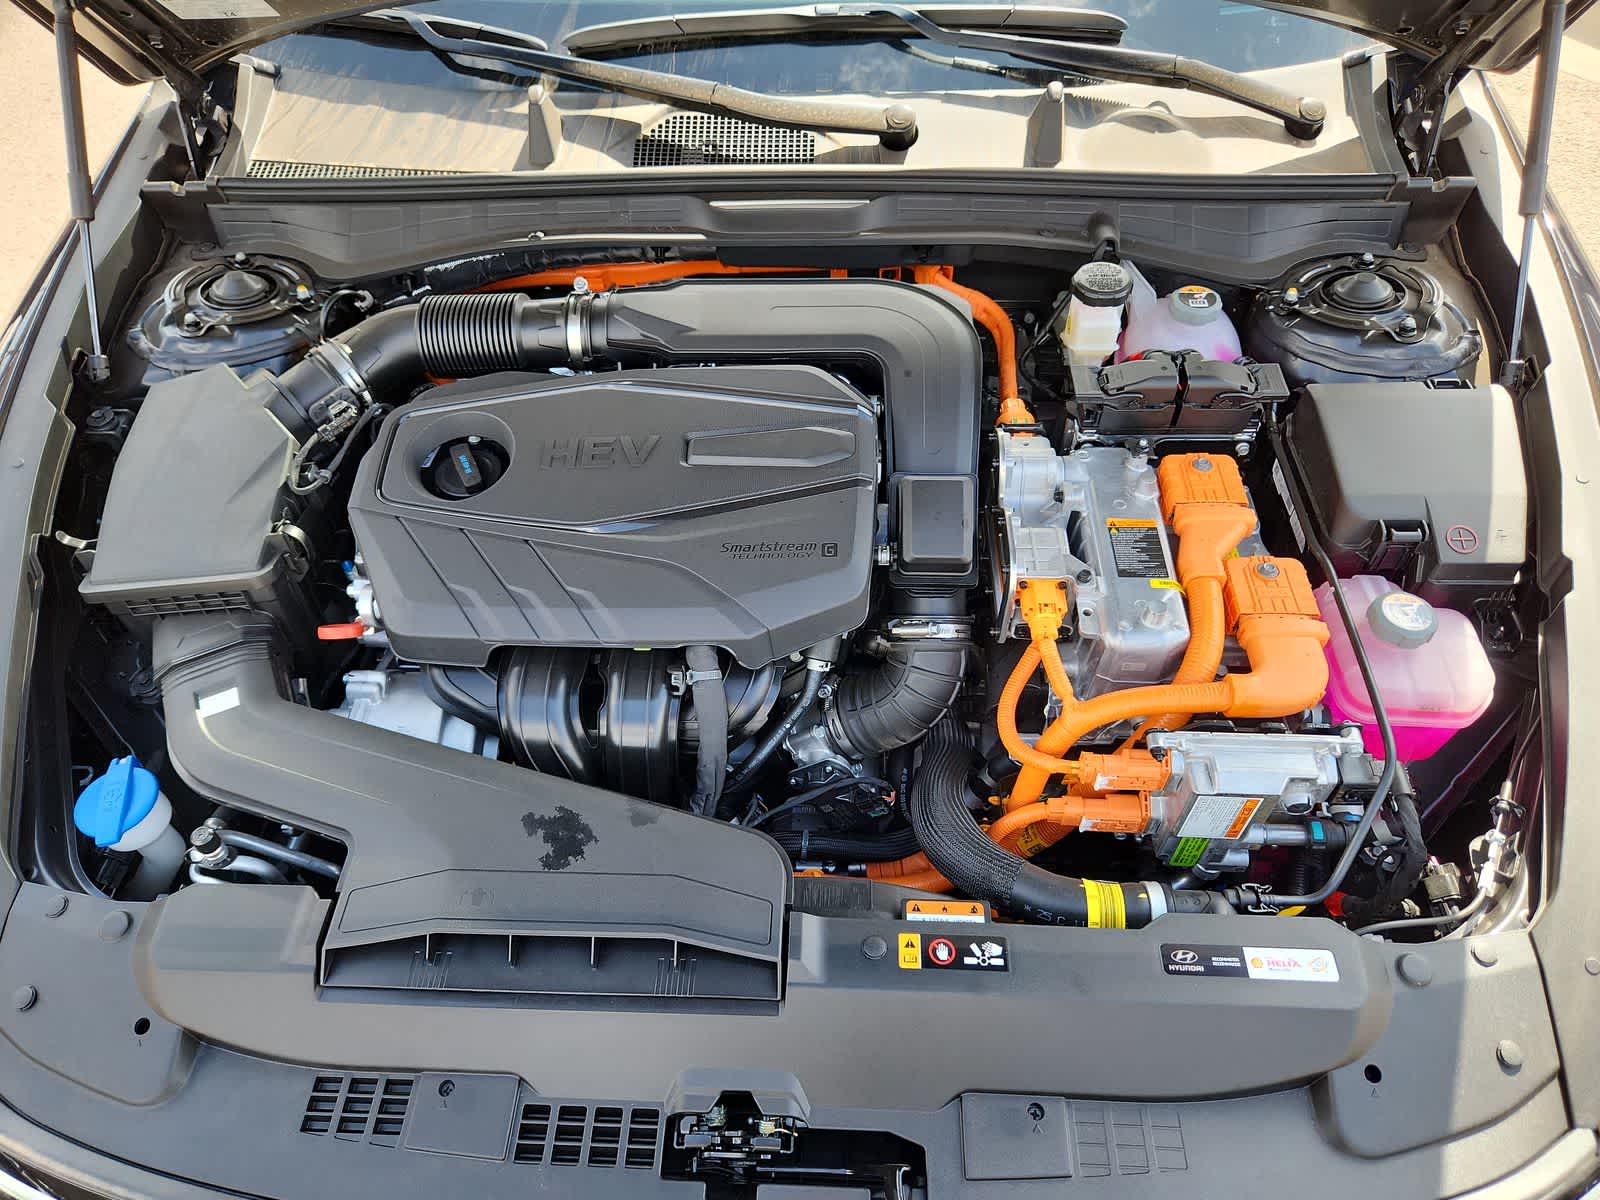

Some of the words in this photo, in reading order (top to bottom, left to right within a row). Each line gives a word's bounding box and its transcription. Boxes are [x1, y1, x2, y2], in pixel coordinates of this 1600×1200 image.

[538, 433, 662, 471] HEV
[720, 541, 817, 553] Smartstream
[731, 551, 814, 560] TECHNOLOGY
[1168, 964, 1204, 972] HYUNDAI
